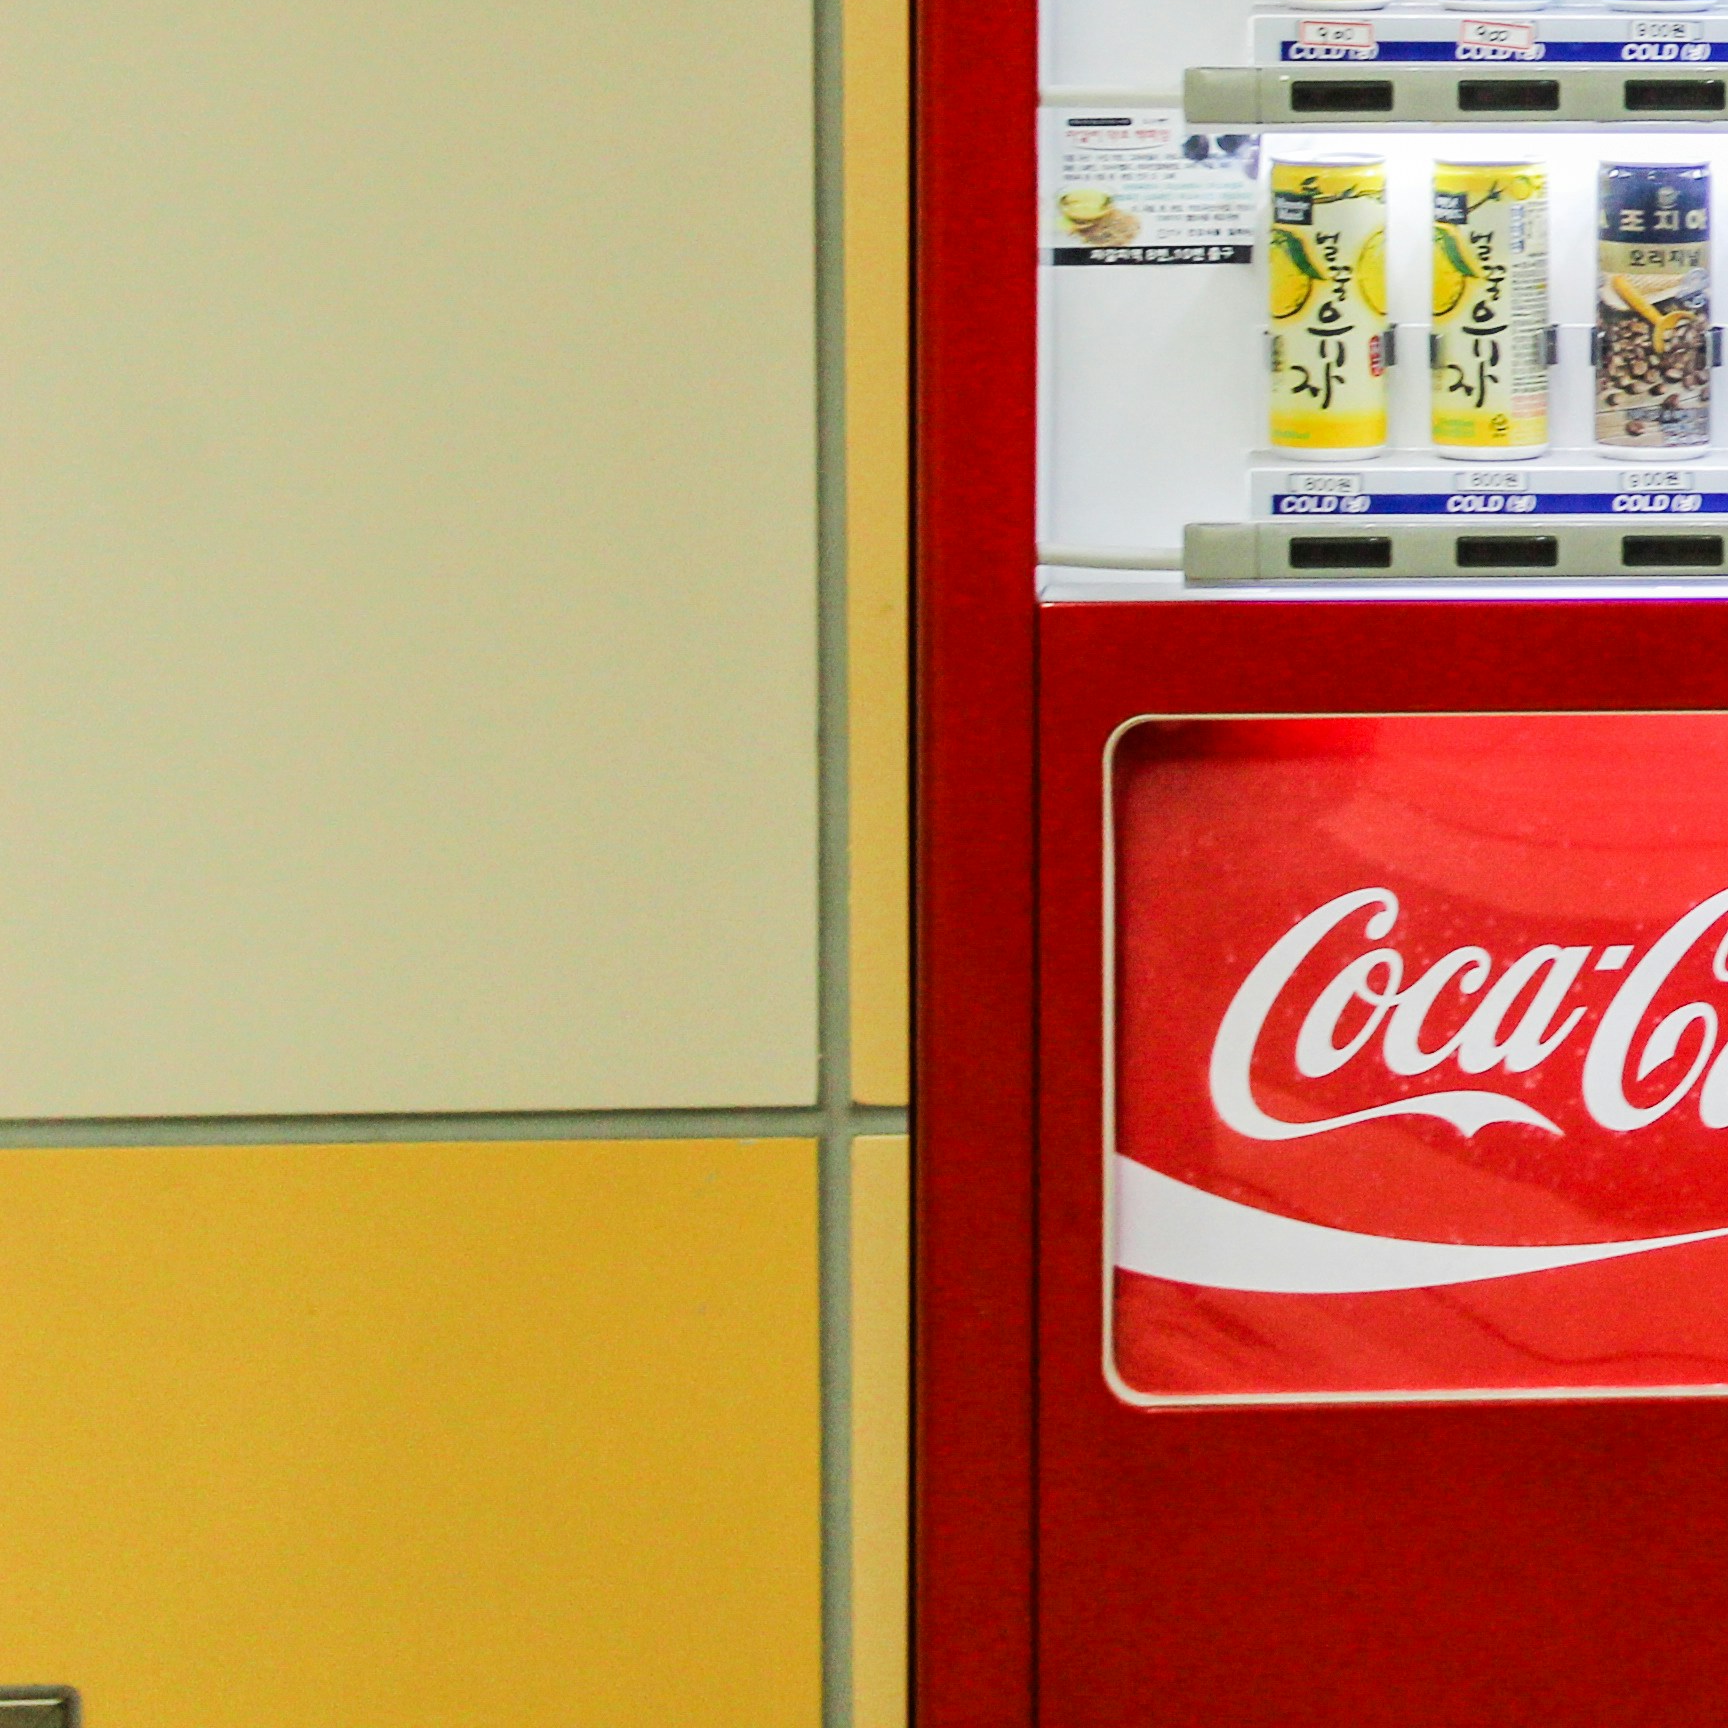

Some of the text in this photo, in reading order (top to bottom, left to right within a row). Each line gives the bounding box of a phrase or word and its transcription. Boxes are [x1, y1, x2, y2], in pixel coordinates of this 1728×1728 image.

[1620, 41, 1677, 62] COLD
[1279, 492, 1336, 515] COLD
[1446, 492, 1503, 515] COLD
[1611, 492, 1668, 515] COLD
